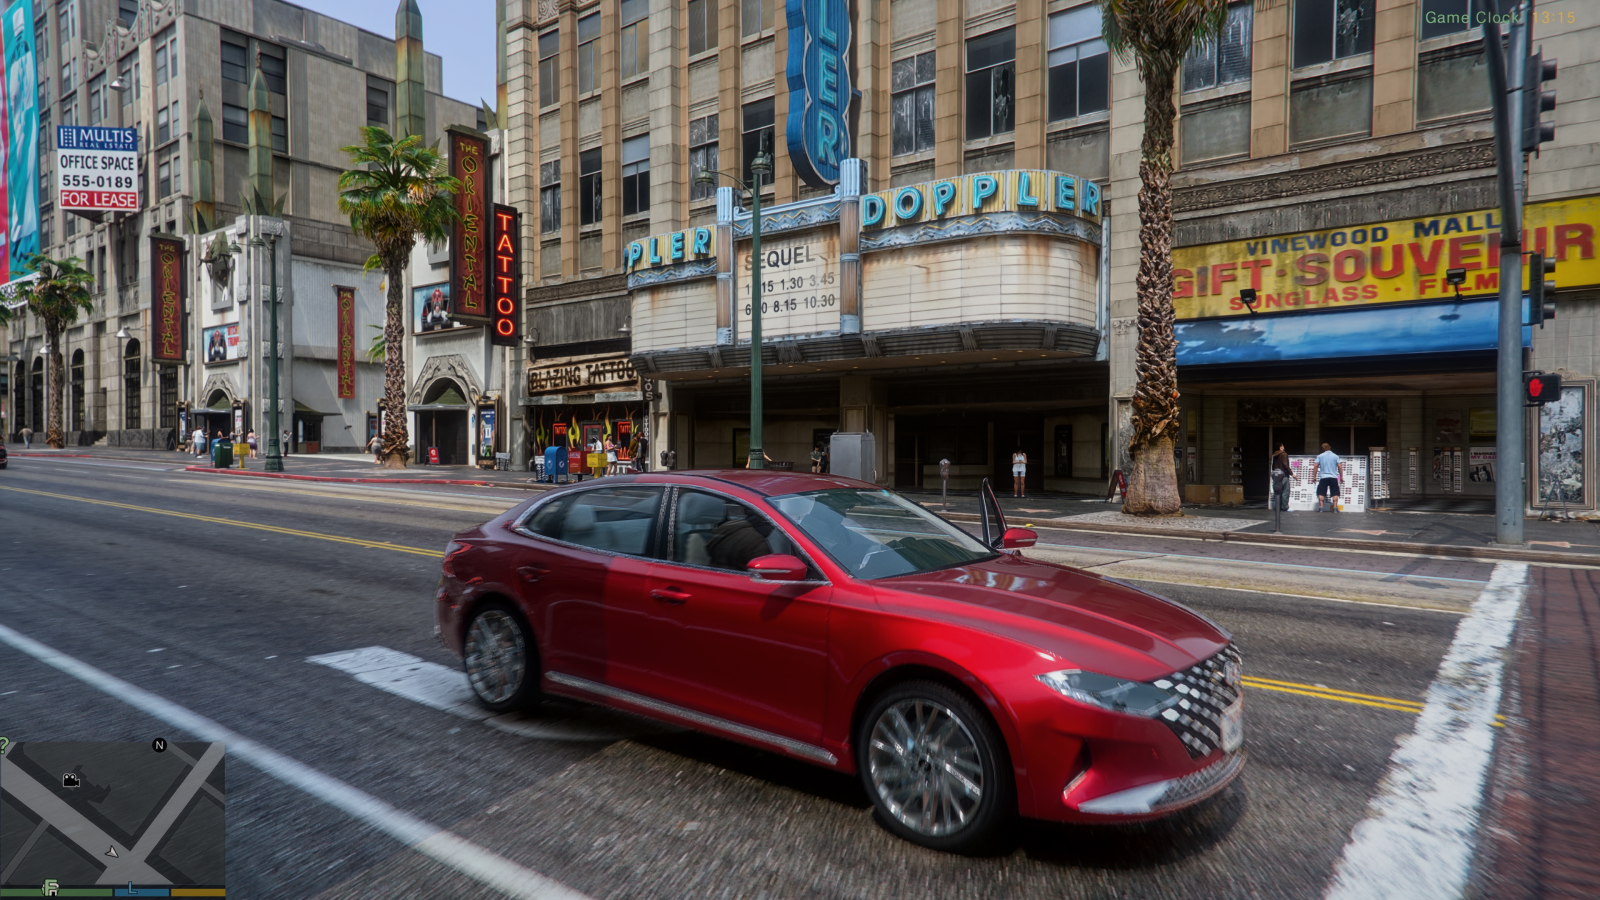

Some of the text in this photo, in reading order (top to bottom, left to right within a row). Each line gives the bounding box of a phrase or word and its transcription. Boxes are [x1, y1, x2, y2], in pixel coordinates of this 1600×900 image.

[80, 128, 133, 143] MULTIS
[459, 142, 479, 155] THE
[60, 154, 134, 171] OFFICE SPACE
[62, 174, 133, 188] 555-0189
[61, 191, 136, 207] FOR LEASE
[862, 171, 1100, 227] DOPPLER
[461, 156, 480, 309] ORIENTAL
[1246, 212, 1501, 256] VINEWOOD MALL
[624, 227, 712, 273] PLER
[496, 212, 514, 336] TATTOO
[780, 276, 803, 291] 1.30
[809, 271, 835, 287] 3.45
[1171, 258, 1272, 299] GIFT
[160, 252, 177, 356] ORIENTAL
[773, 298, 797, 313] 8.15
[803, 293, 835, 309] 10.30
[341, 299, 351, 396] ORIENTAL
[530, 365, 581, 391] BLAZING
